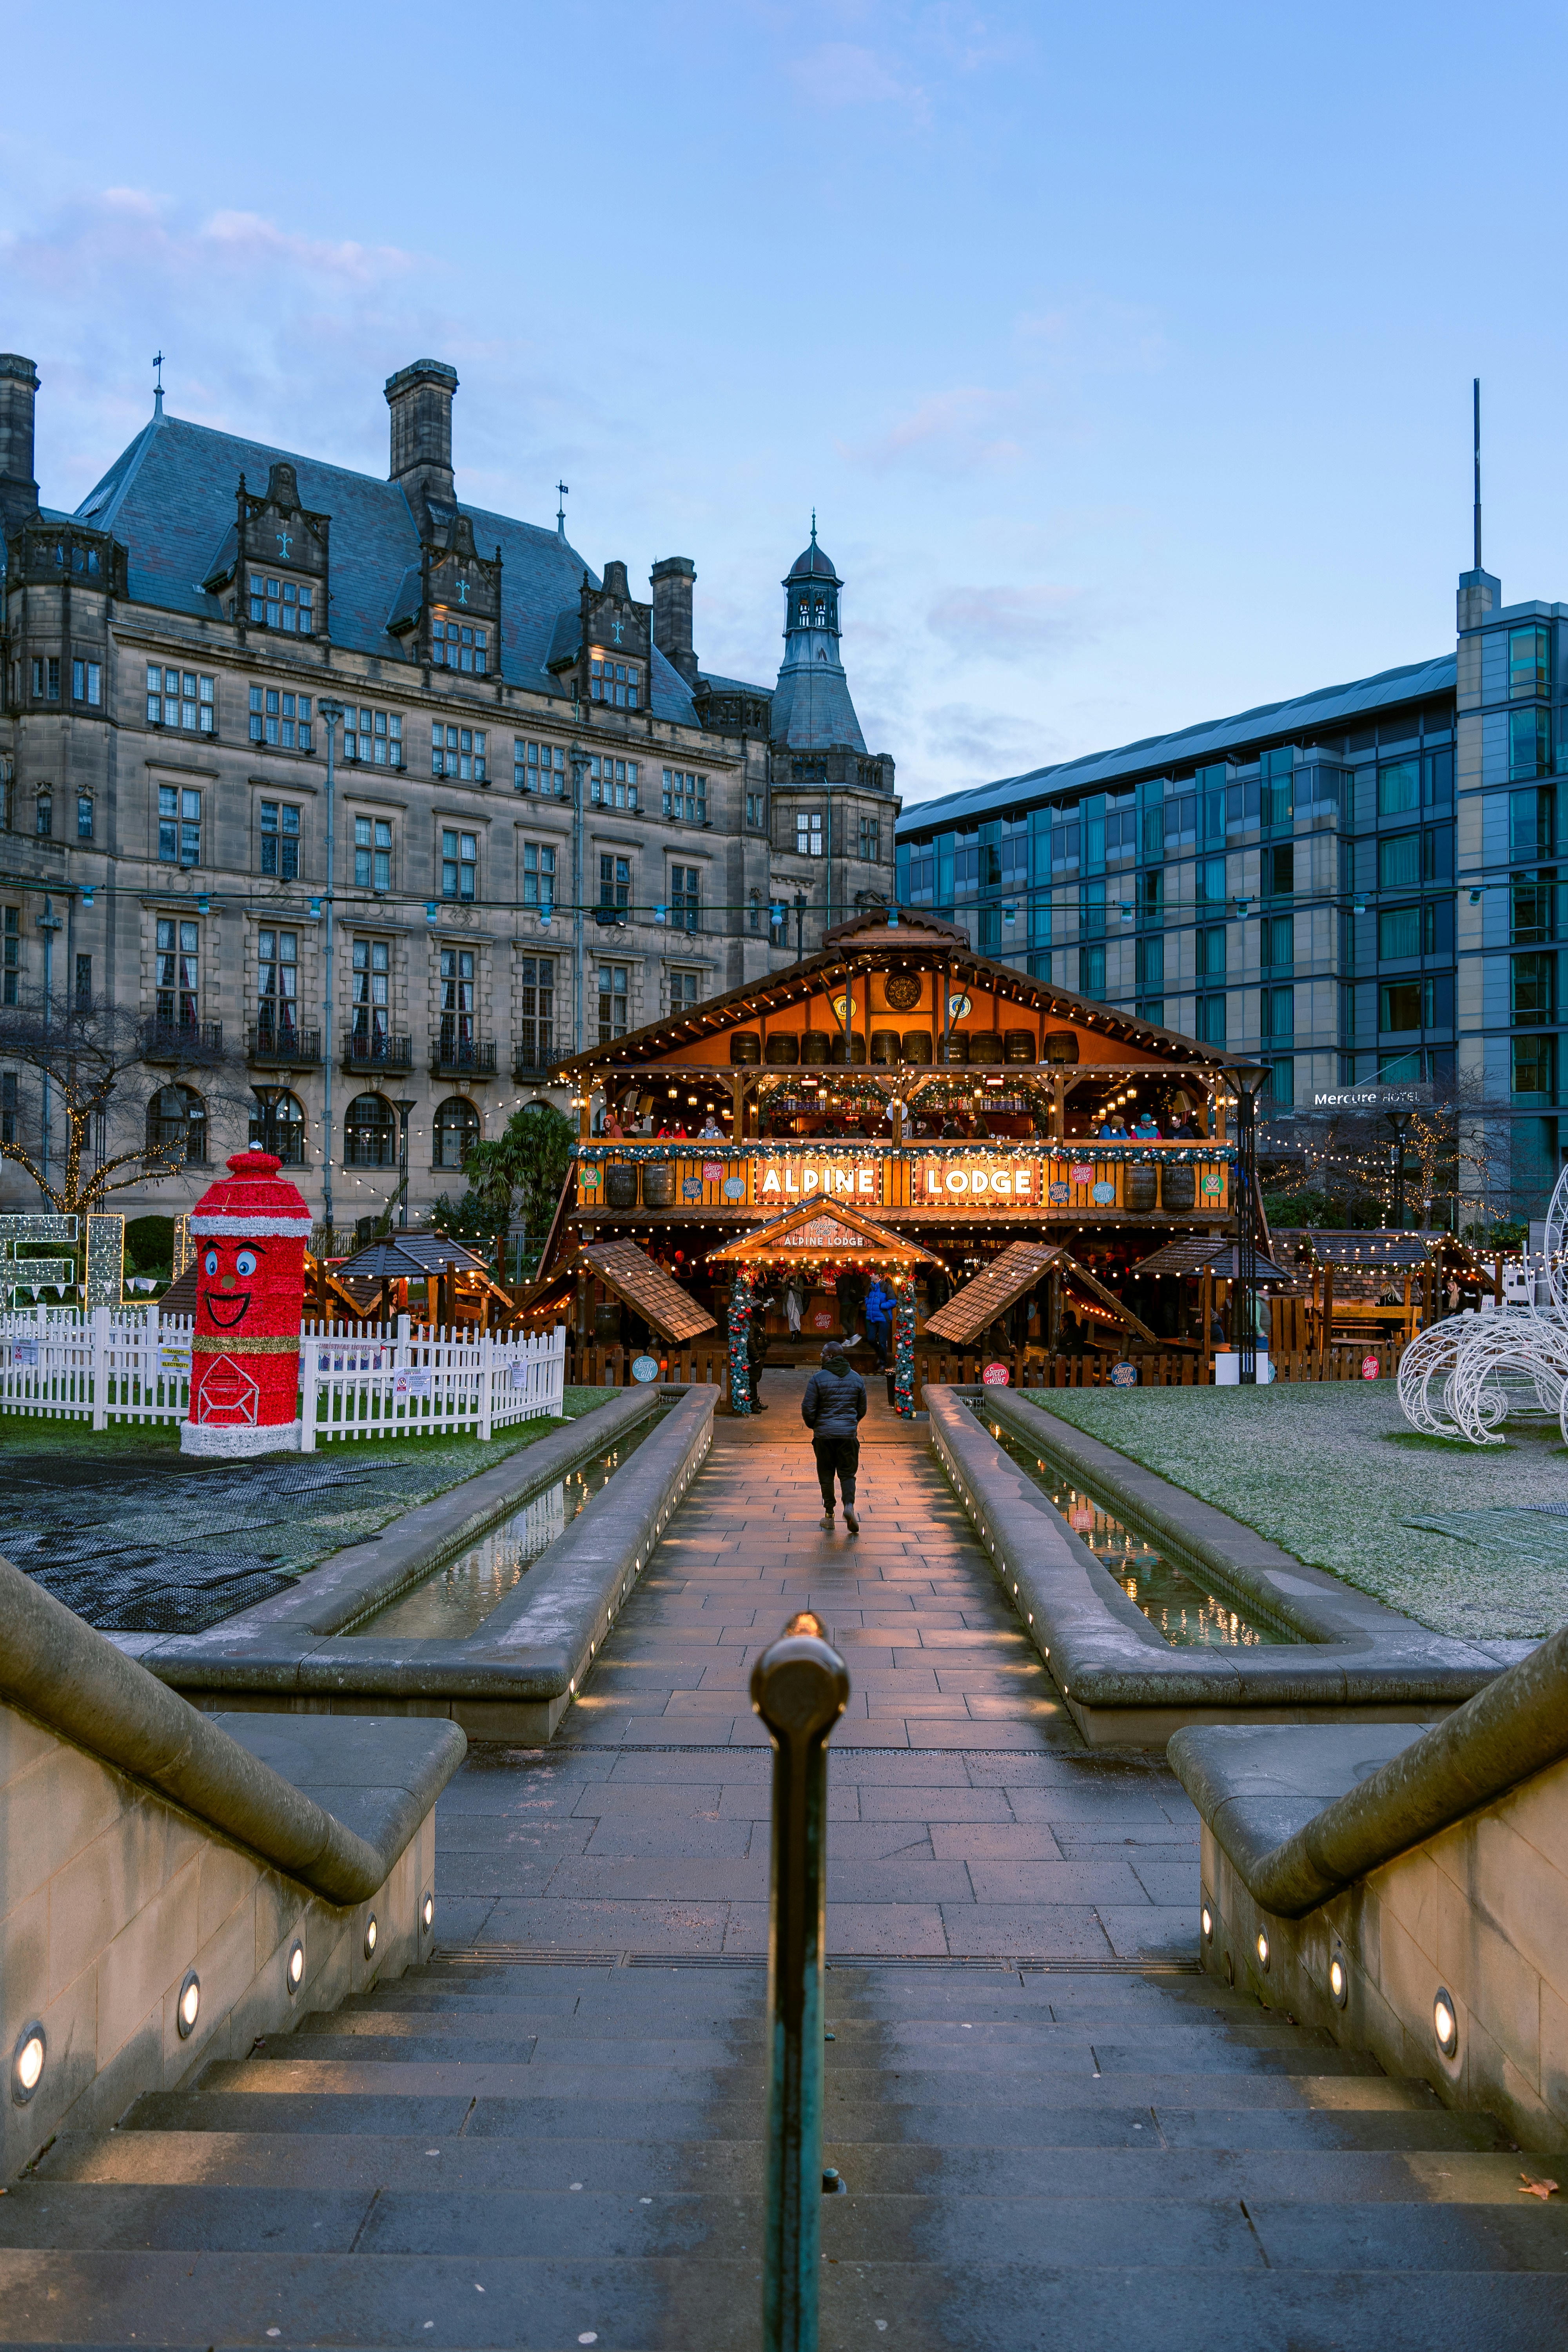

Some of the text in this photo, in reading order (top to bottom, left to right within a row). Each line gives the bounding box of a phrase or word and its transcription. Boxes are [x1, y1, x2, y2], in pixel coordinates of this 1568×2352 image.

[1315, 1093, 1376, 1105] Mercure
[1383, 1091, 1420, 1102] HOTEL
[761, 1169, 875, 1193] ALPINE
[928, 1169, 1032, 1194] LODGE
[810, 1221, 838, 1229] Welcome
[784, 1237, 863, 1246] ALPINE LODGE
[635, 1360, 655, 1368] SPICED
[1364, 1361, 1377, 1369] SPICED
[985, 1368, 1006, 1377] SPICED
